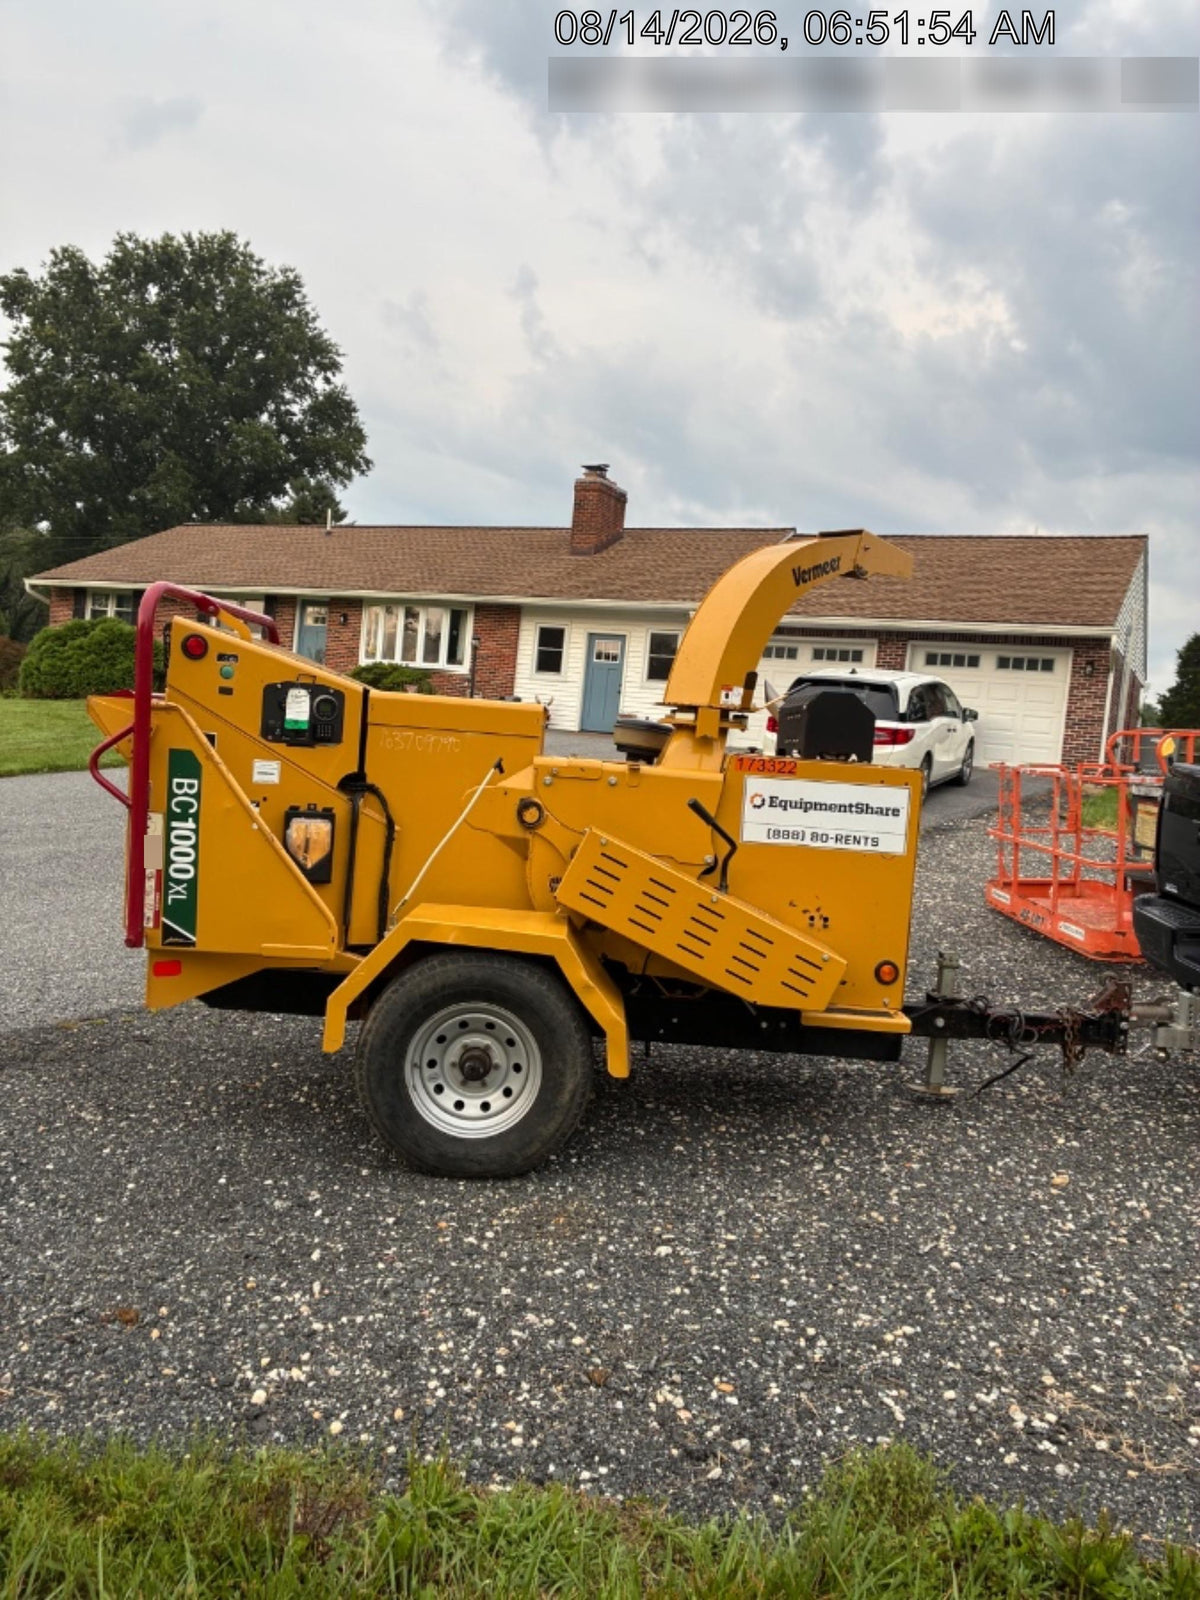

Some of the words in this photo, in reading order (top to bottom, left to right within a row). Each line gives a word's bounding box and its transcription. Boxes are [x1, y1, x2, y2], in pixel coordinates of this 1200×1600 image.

[791, 555, 841, 587] Vermeer
[737, 757, 797, 775] 173322
[767, 795, 902, 818] EquipmentShare
[766, 827, 806, 843] (888)
[809, 832, 880, 848] 80-RENTS
